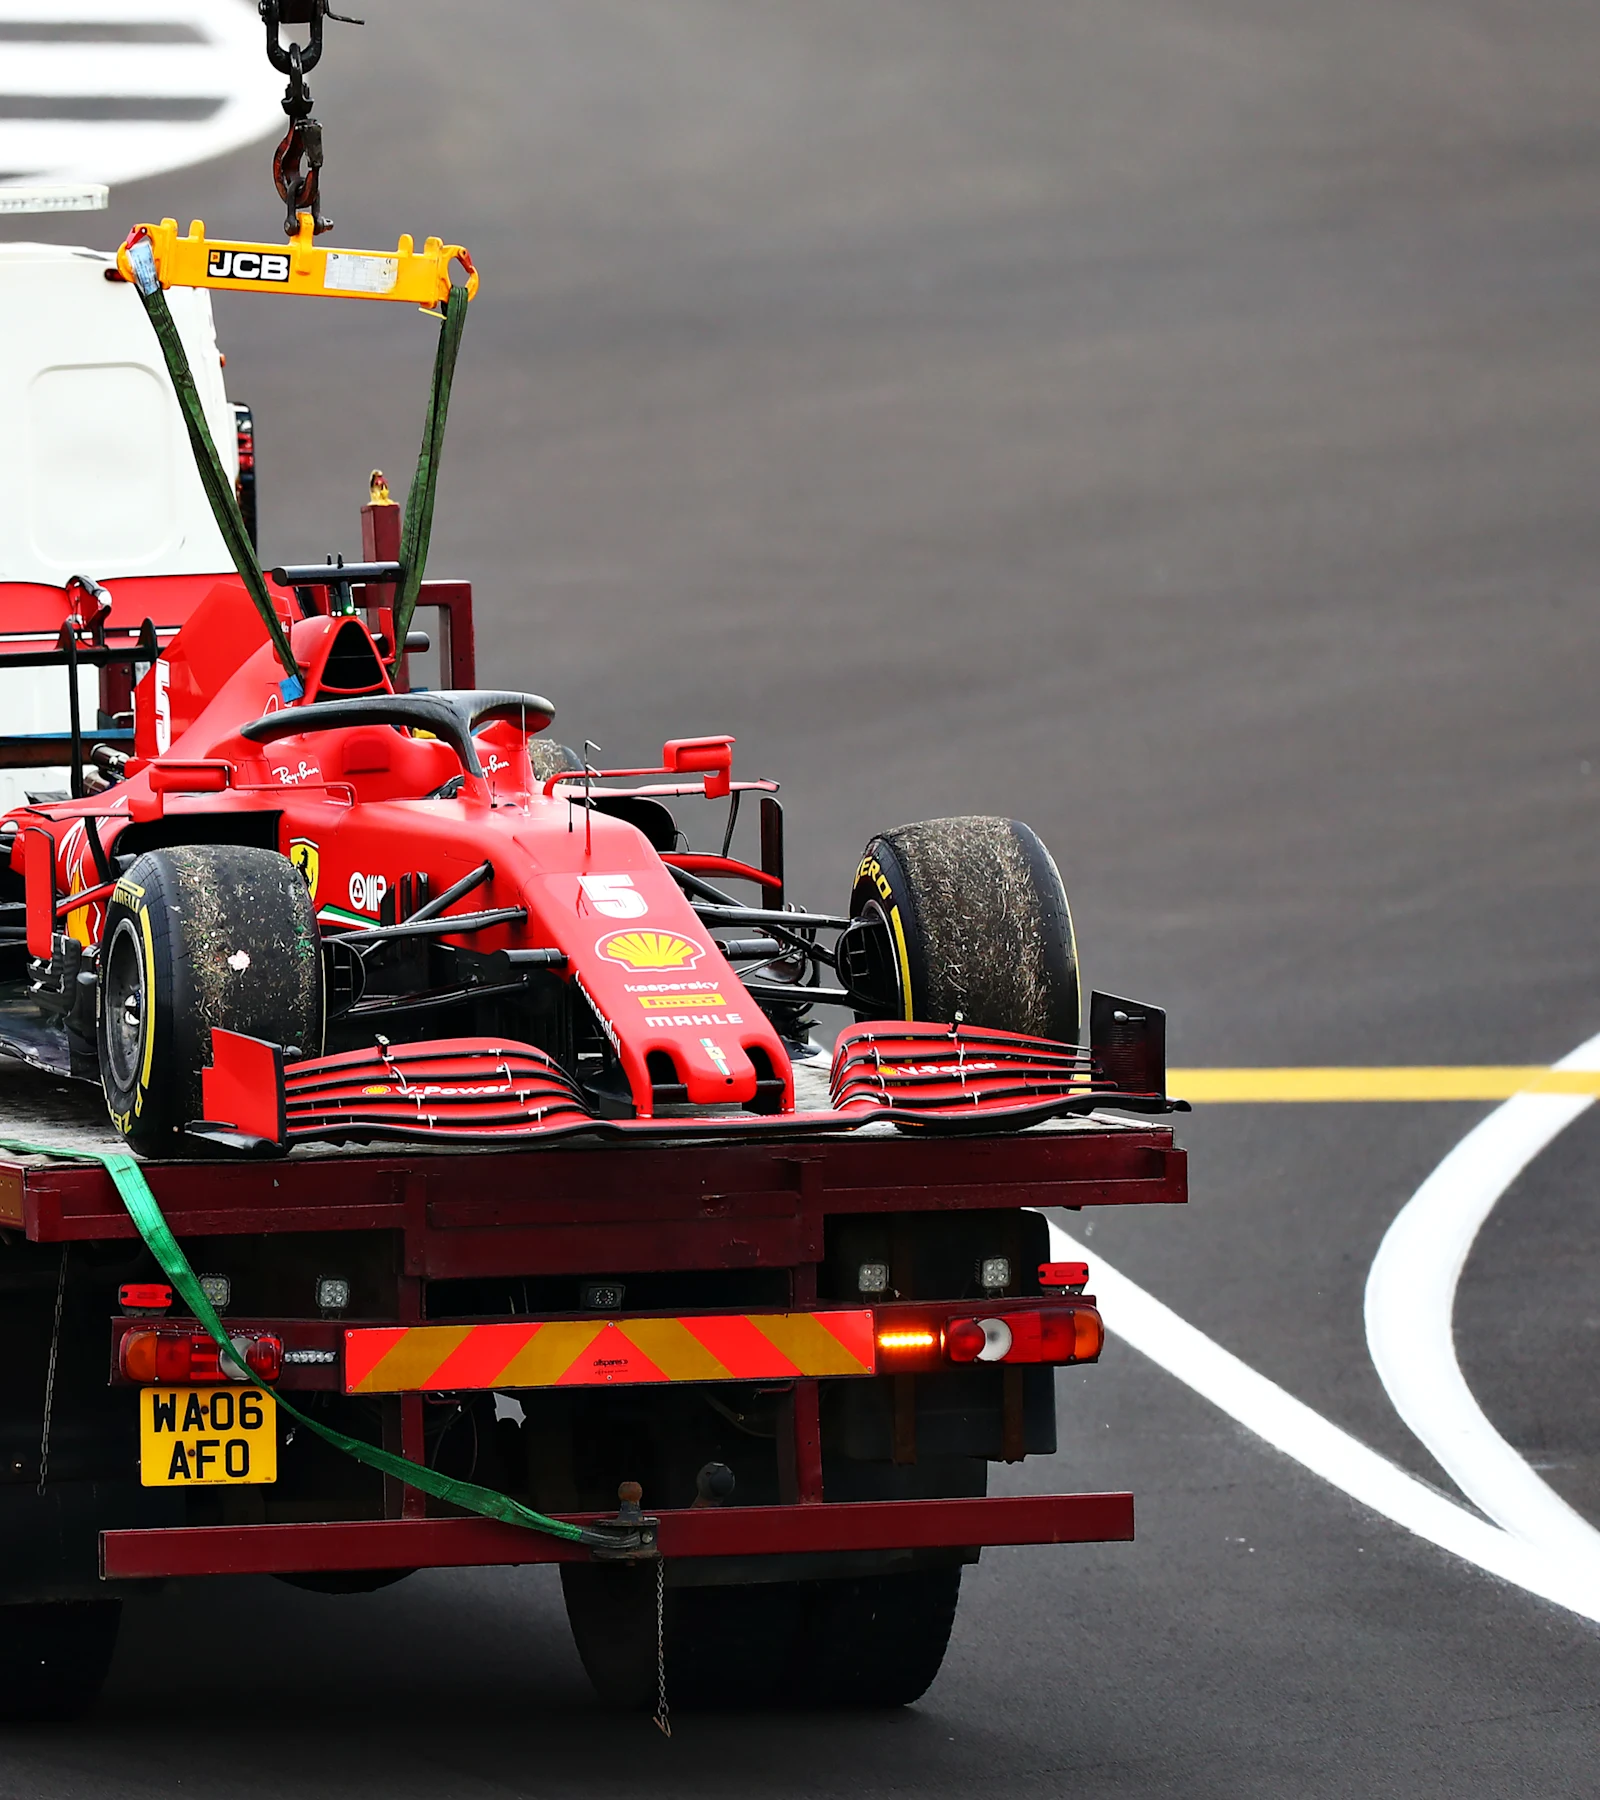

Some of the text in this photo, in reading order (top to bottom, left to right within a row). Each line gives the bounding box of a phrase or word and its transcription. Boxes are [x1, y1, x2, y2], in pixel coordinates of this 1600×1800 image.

[209, 252, 289, 281] JCB
[154, 658, 172, 757] 5
[853, 856, 892, 900] ZERO
[576, 874, 649, 919] 5
[623, 980, 720, 993] kaspersky
[644, 1013, 744, 1028] MAHLE
[897, 1062, 998, 1076] V-Power
[396, 1084, 511, 1096] V-Power
[152, 1391, 264, 1433] WA06
[167, 1438, 250, 1480] AFO
